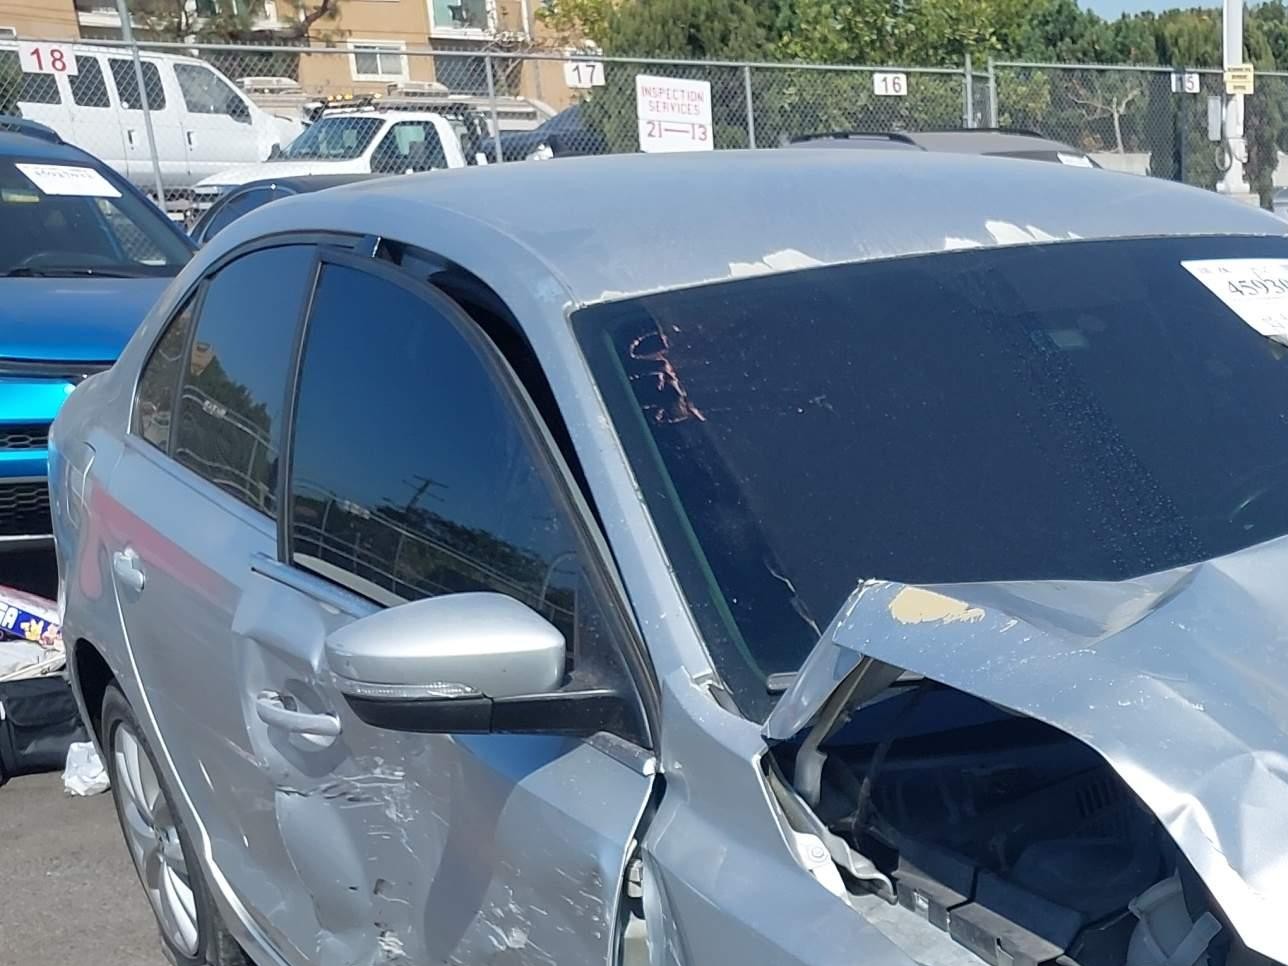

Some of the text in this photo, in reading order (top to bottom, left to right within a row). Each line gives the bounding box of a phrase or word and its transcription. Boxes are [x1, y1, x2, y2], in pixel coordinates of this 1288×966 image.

[30, 47, 66, 72] 18
[572, 64, 596, 84] 17
[641, 86, 704, 102] INSPECTION
[882, 76, 902, 94] 16
[648, 100, 701, 116] SERVICES
